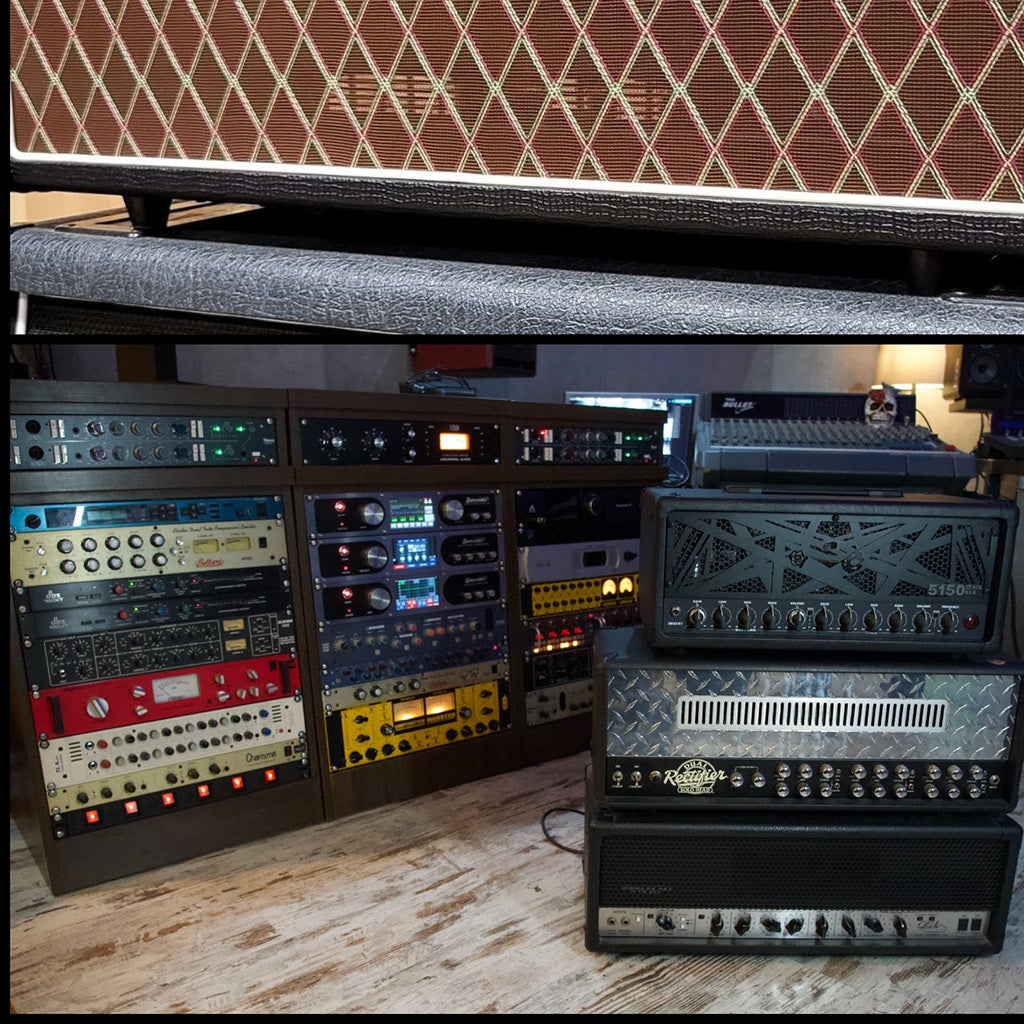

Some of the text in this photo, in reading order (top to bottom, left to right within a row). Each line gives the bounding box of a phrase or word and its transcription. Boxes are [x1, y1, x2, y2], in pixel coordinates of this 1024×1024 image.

[927, 583, 966, 597] 5150
[684, 761, 708, 770] DUAL
[663, 769, 729, 787] Rectifier
